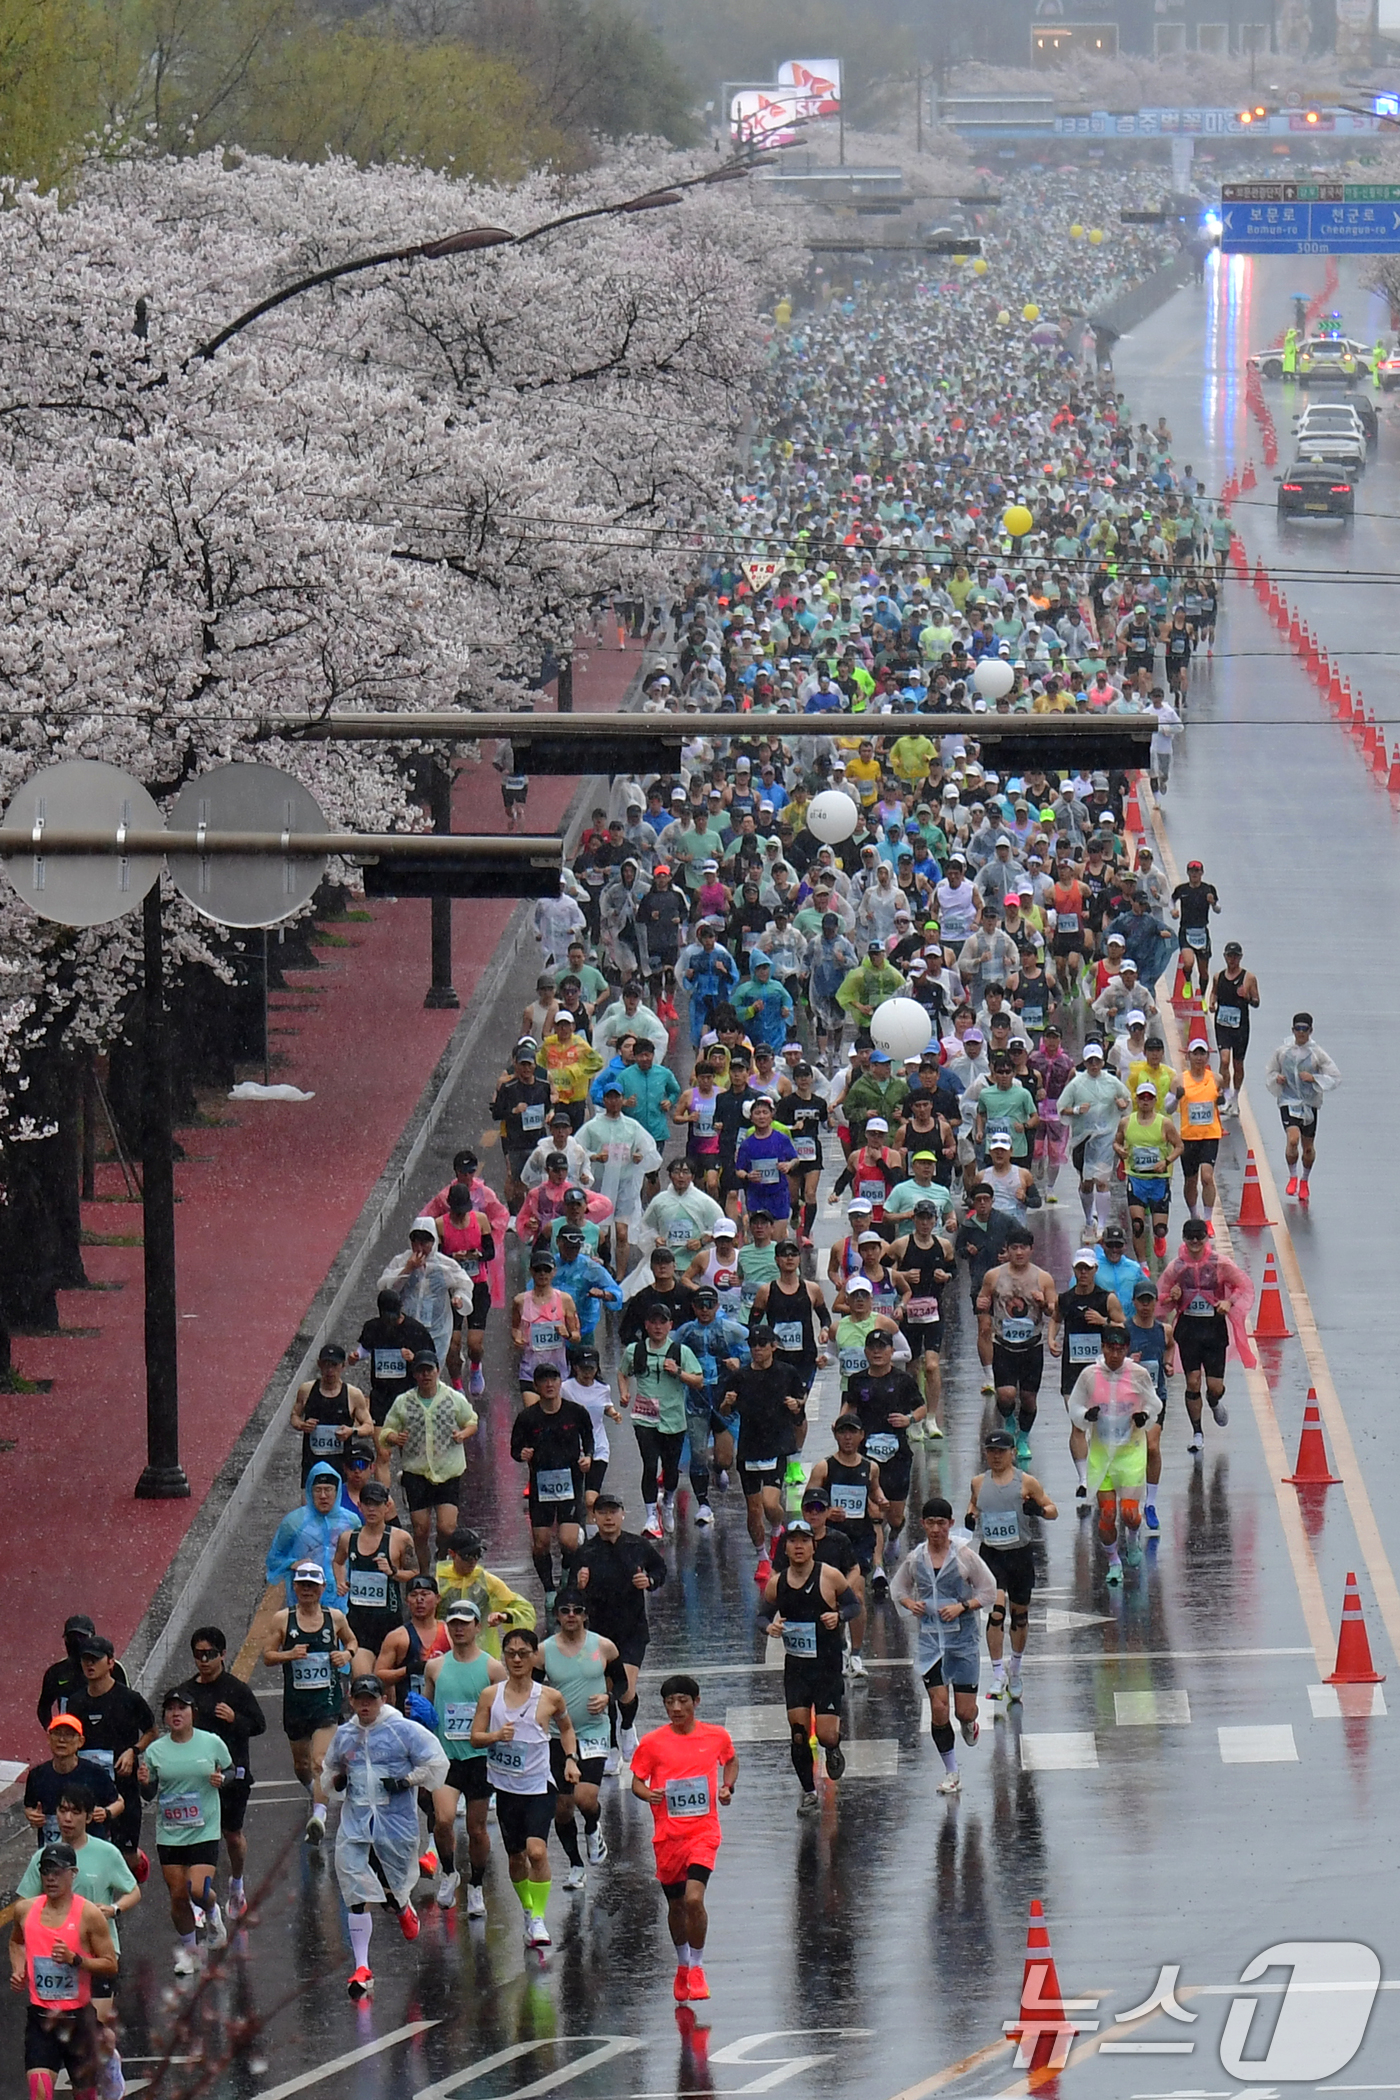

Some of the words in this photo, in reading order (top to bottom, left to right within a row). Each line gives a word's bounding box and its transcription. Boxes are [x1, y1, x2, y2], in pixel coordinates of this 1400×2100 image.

[796, 101, 821, 117] SK
[1250, 208, 1296, 224] 보문로
[1332, 208, 1376, 224] 천군로
[1297, 242, 1329, 253] 300m
[1191, 1111, 1212, 1120] 2120
[860, 1189, 884, 1200] 4058
[780, 1333, 802, 1345] 448
[1071, 1345, 1099, 1356] 1395
[540, 1481, 570, 1494] 4302
[833, 1497, 863, 1511] 1539
[984, 1523, 1016, 1538] 3486
[351, 1585, 385, 1599] 3428
[294, 1667, 329, 1681] 3370
[488, 1749, 523, 1768] 2438
[670, 1793, 707, 1809] 1548
[164, 1805, 200, 1820] 6619
[36, 1974, 75, 1990] 2672
